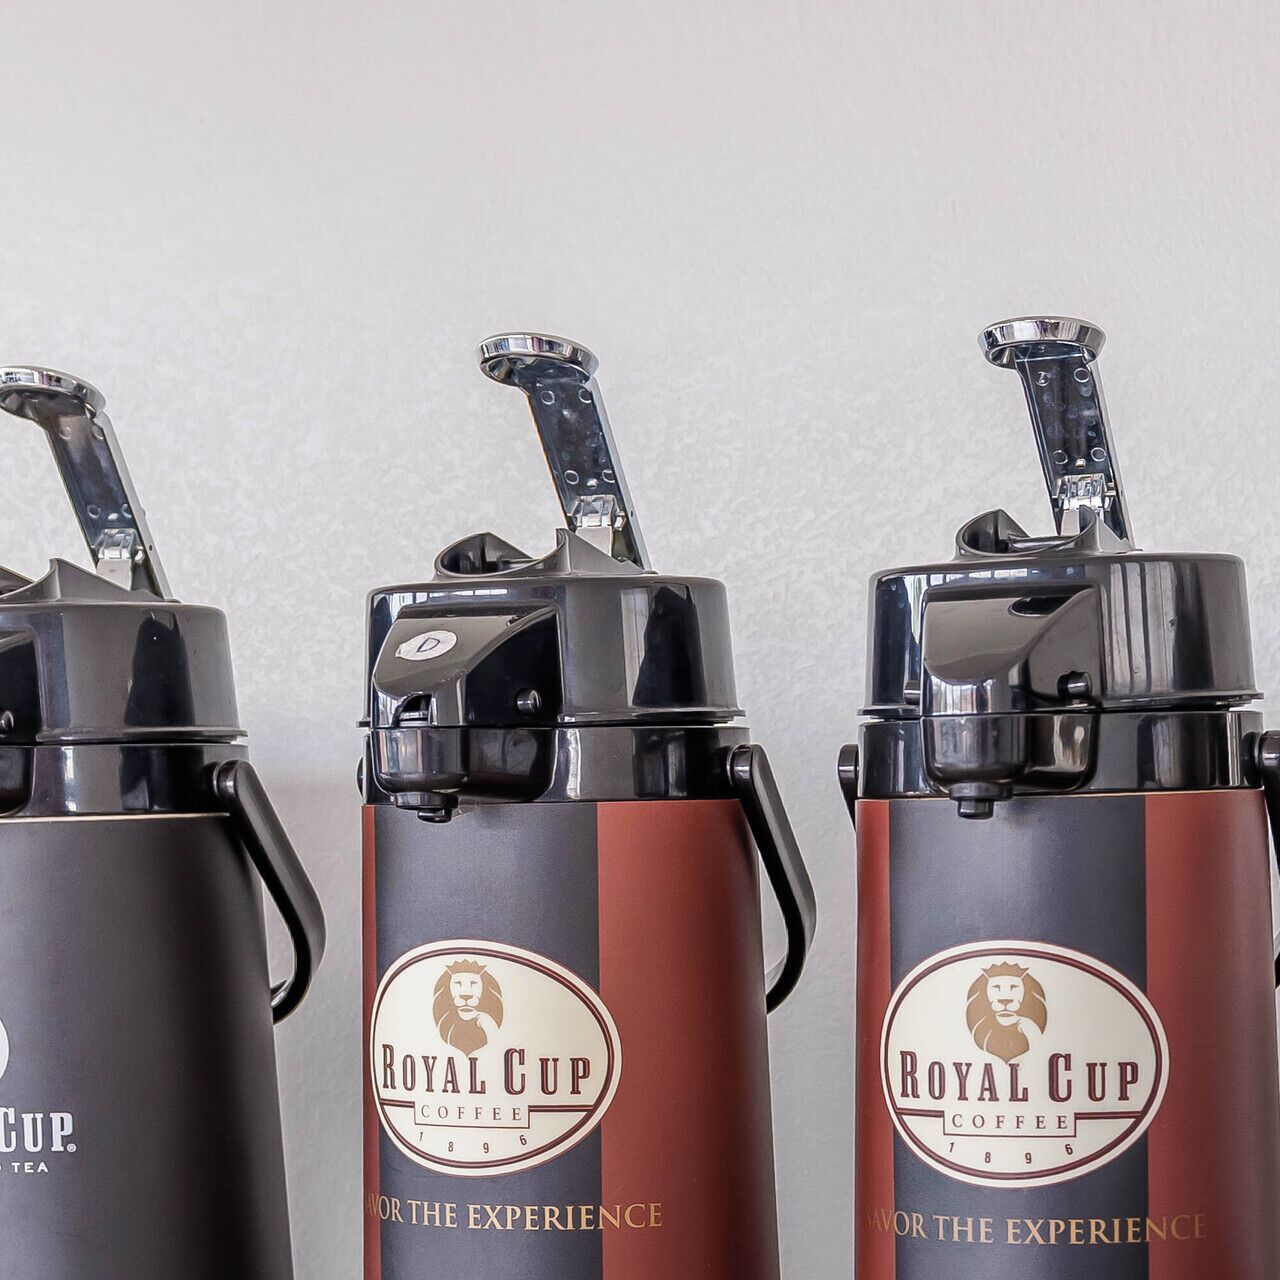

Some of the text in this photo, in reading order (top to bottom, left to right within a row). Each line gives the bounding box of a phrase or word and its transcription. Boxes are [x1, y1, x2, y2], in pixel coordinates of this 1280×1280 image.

[417, 637, 440, 652] D
[380, 1042, 591, 1096] ROYAL CUP
[899, 1050, 1140, 1103] ROYAL CUP
[420, 1104, 522, 1121] COFFEE
[951, 1113, 1068, 1130] COFFEE
[11, 1162, 49, 1173] TEA
[406, 1199, 458, 1228] THE
[466, 1202, 664, 1232] EXPERIENCE
[932, 1214, 994, 1243] THE
[1005, 1213, 1207, 1246] EXPERIENCE
